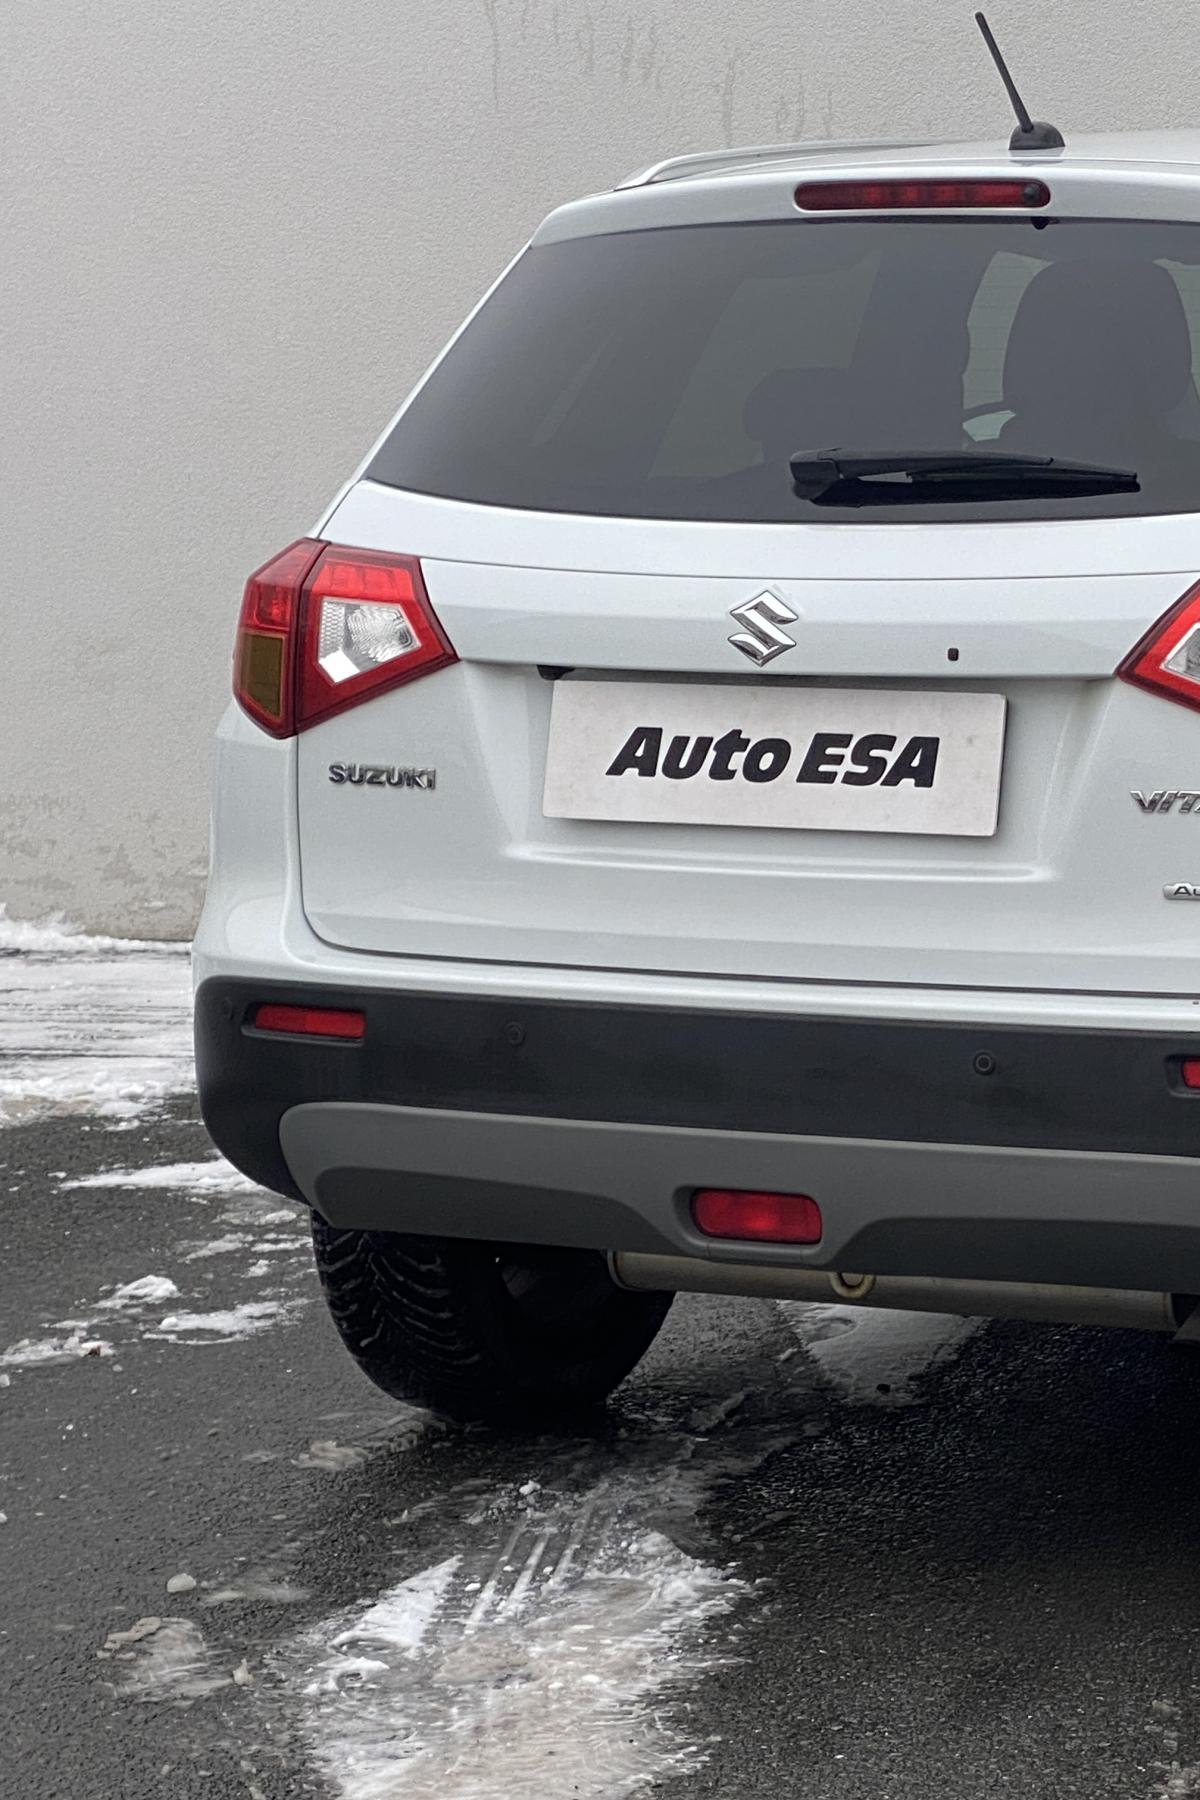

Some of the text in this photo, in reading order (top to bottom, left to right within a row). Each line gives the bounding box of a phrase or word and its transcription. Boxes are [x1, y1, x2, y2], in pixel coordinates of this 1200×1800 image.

[328, 762, 437, 790] SUZUKI
[605, 726, 940, 789] Auto ESA
